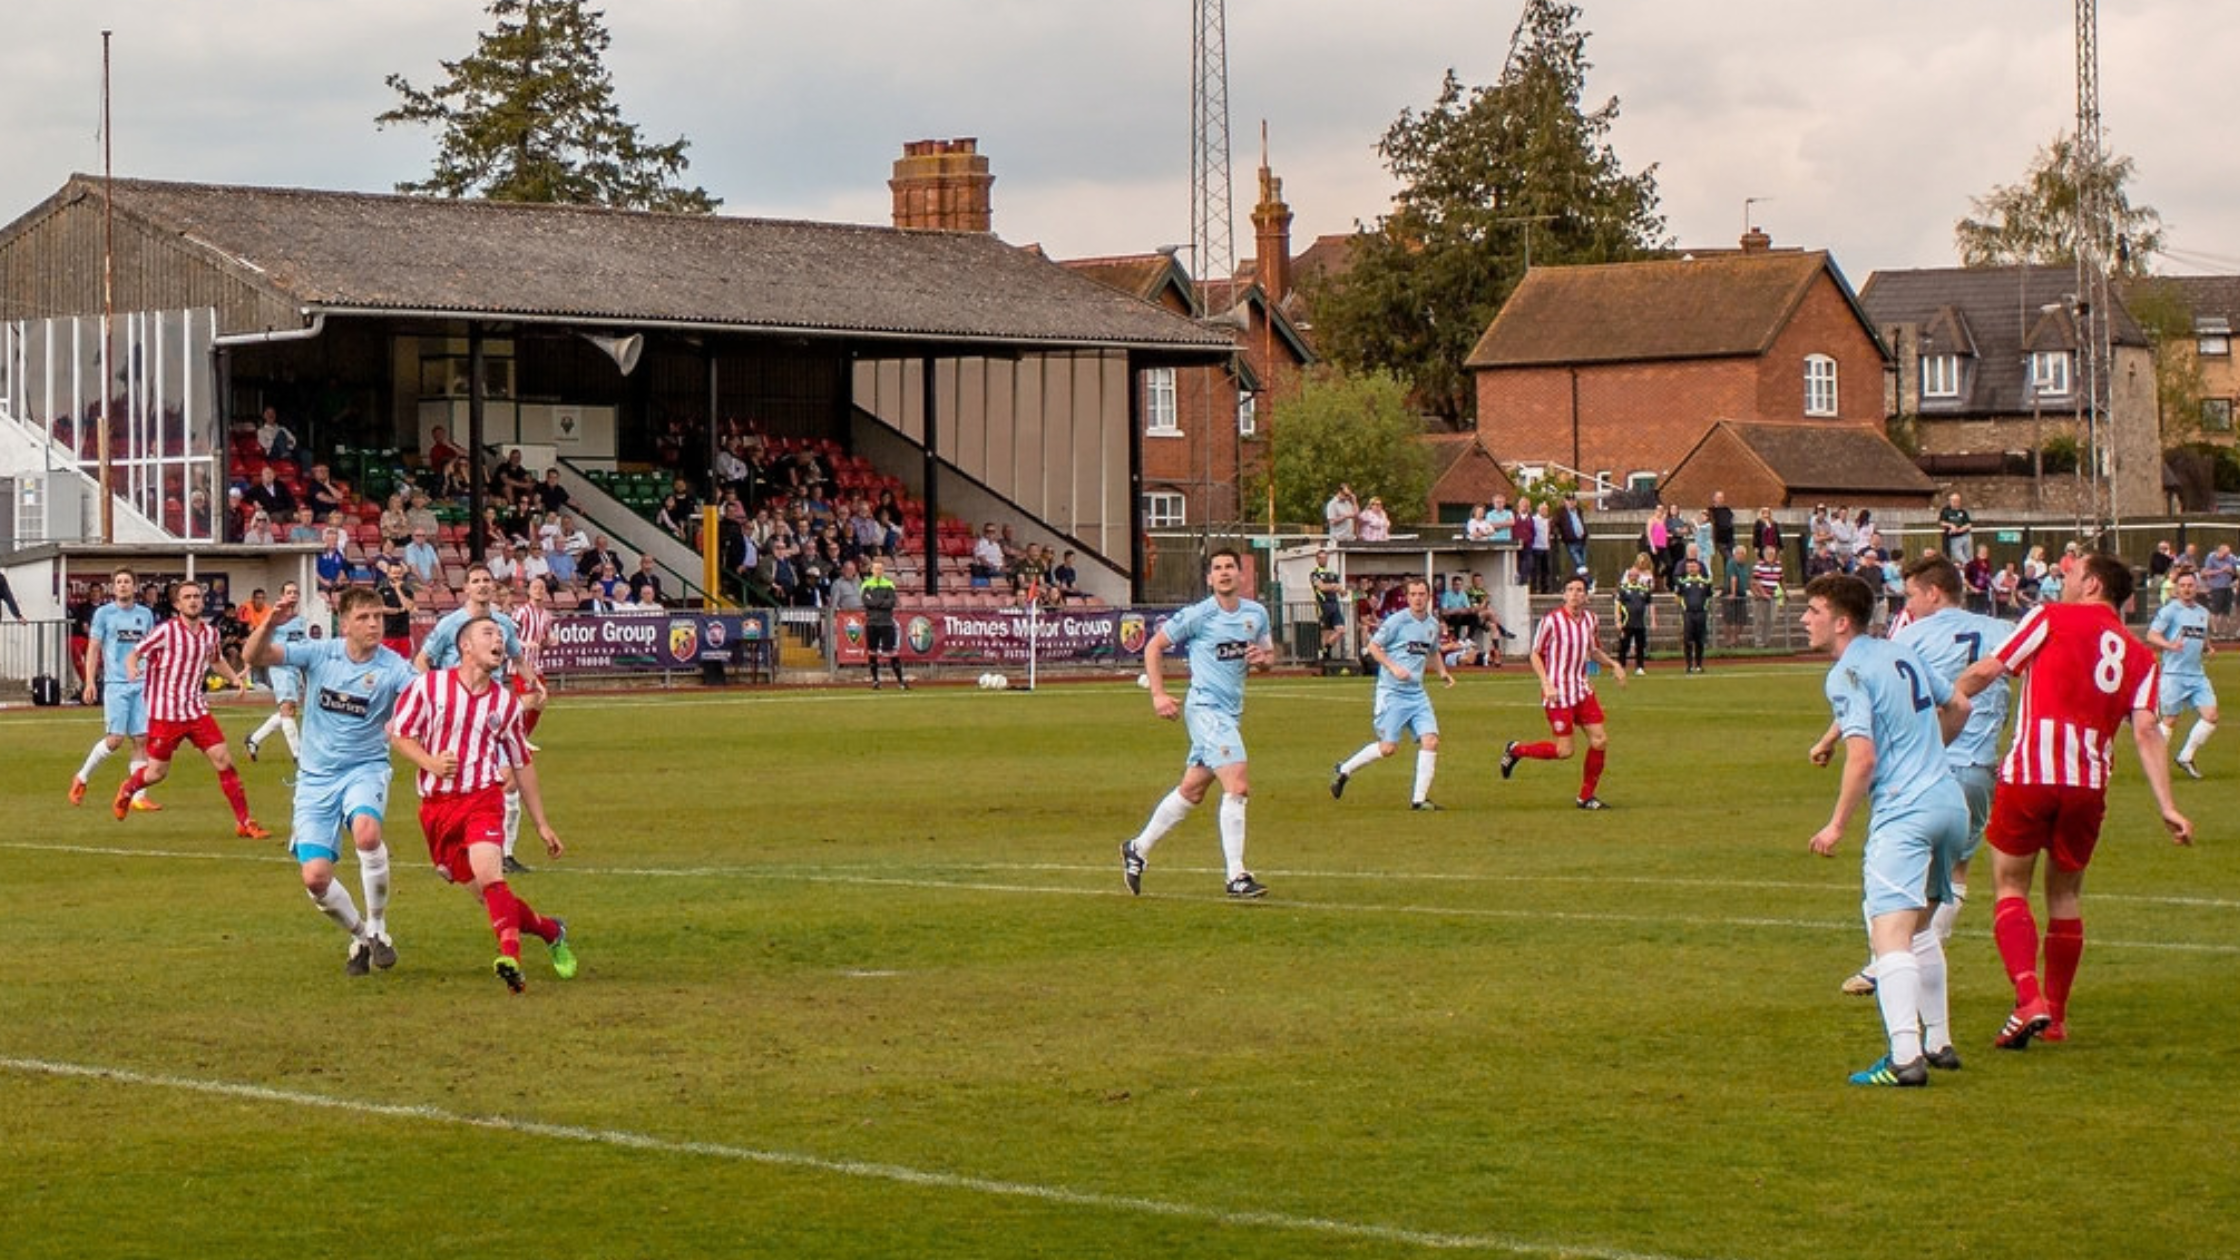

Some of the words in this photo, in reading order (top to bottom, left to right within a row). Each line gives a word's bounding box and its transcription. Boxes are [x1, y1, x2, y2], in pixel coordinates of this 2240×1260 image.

[602, 620, 656, 645] Group
[943, 616, 1009, 638] Thames
[1063, 616, 1113, 638] Group
[1954, 631, 1981, 664] 7
[2095, 629, 2126, 694] 8
[1894, 659, 1933, 713] 2
